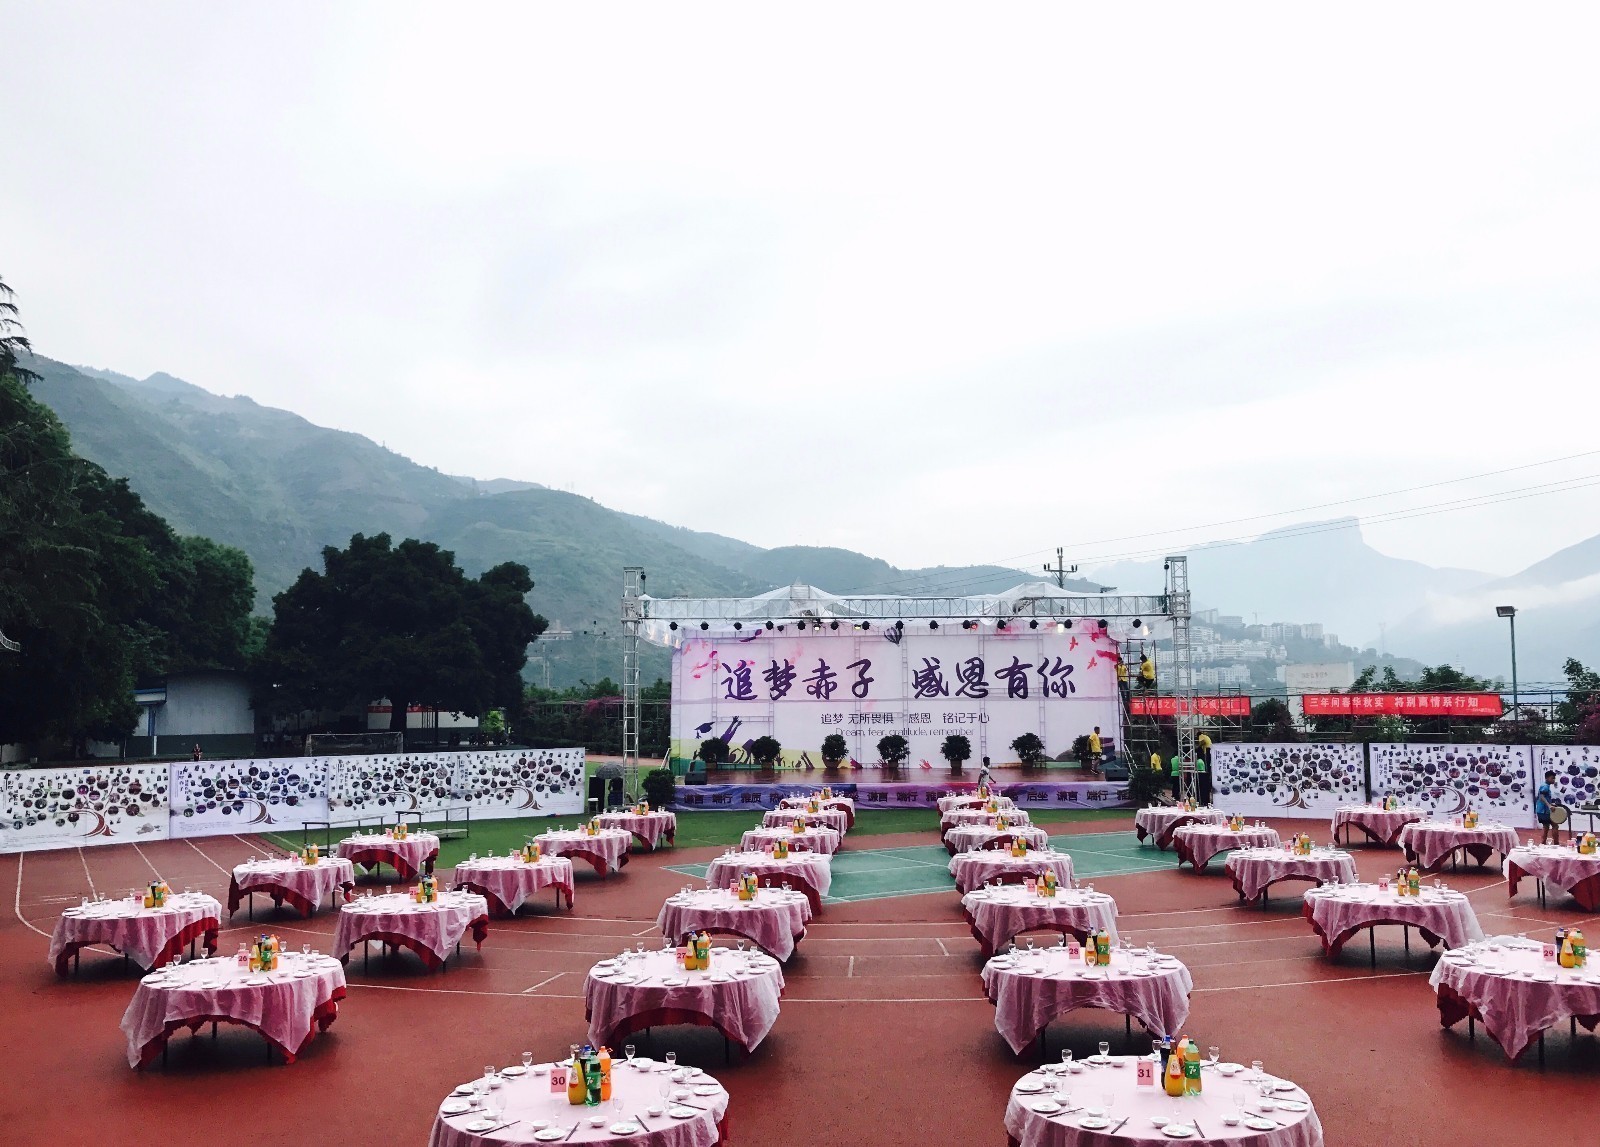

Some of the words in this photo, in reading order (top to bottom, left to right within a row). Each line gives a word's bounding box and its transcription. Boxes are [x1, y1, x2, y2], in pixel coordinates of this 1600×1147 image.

[721, 658, 874, 700] 追梦赤子
[912, 656, 1076, 700] 感恩有你
[1309, 696, 1384, 708] 三年间春华秋实
[820, 713, 844, 725] 追梦
[848, 713, 894, 725] 无所畏惧
[908, 713, 931, 725] 感恩
[942, 713, 990, 724] 铭记于心
[1137, 1068, 1151, 1078] 31
[551, 1076, 566, 1086] 30
